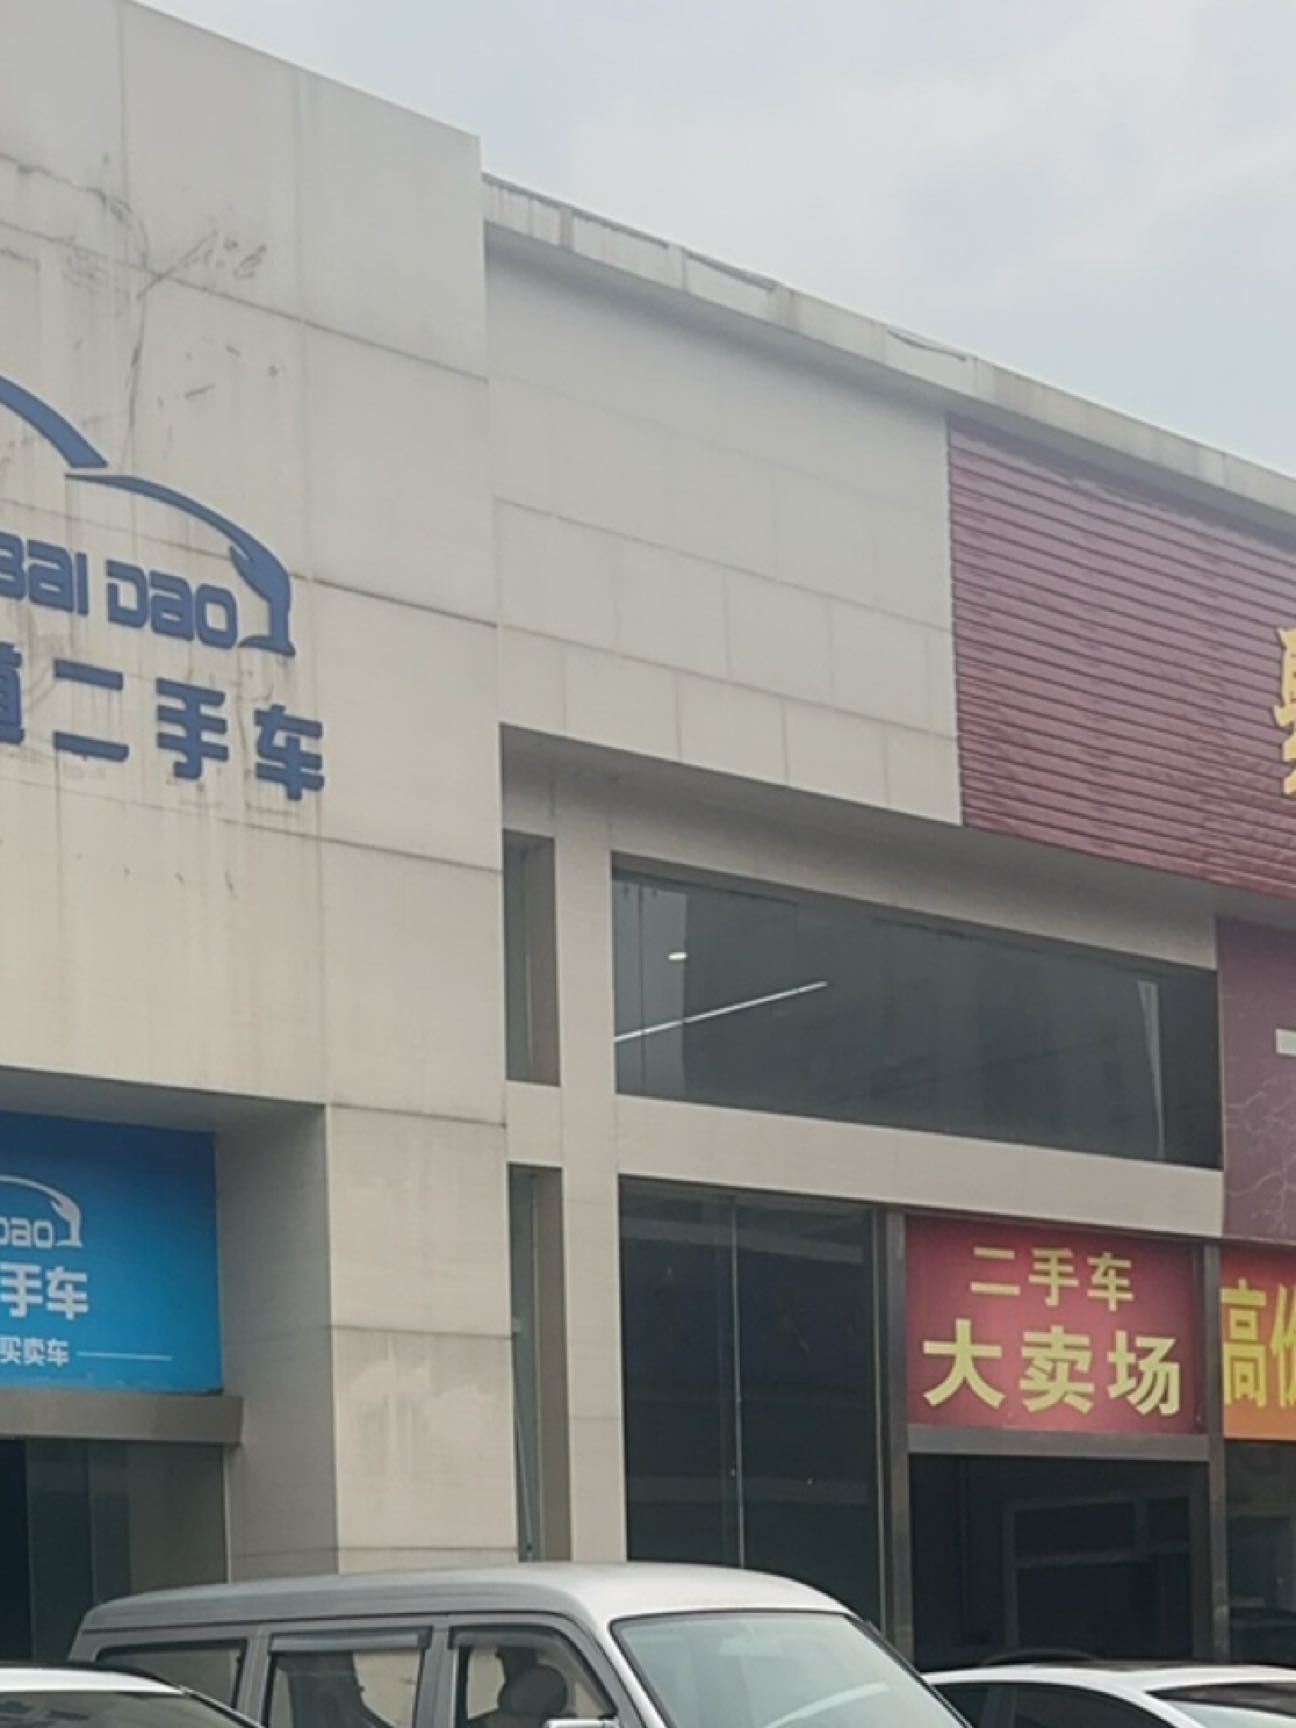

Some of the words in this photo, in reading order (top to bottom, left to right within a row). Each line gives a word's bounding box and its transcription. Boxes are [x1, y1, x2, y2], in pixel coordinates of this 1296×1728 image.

[970, 1246, 1134, 1311] 二手车
[922, 1317, 1180, 1416] 大卖场
